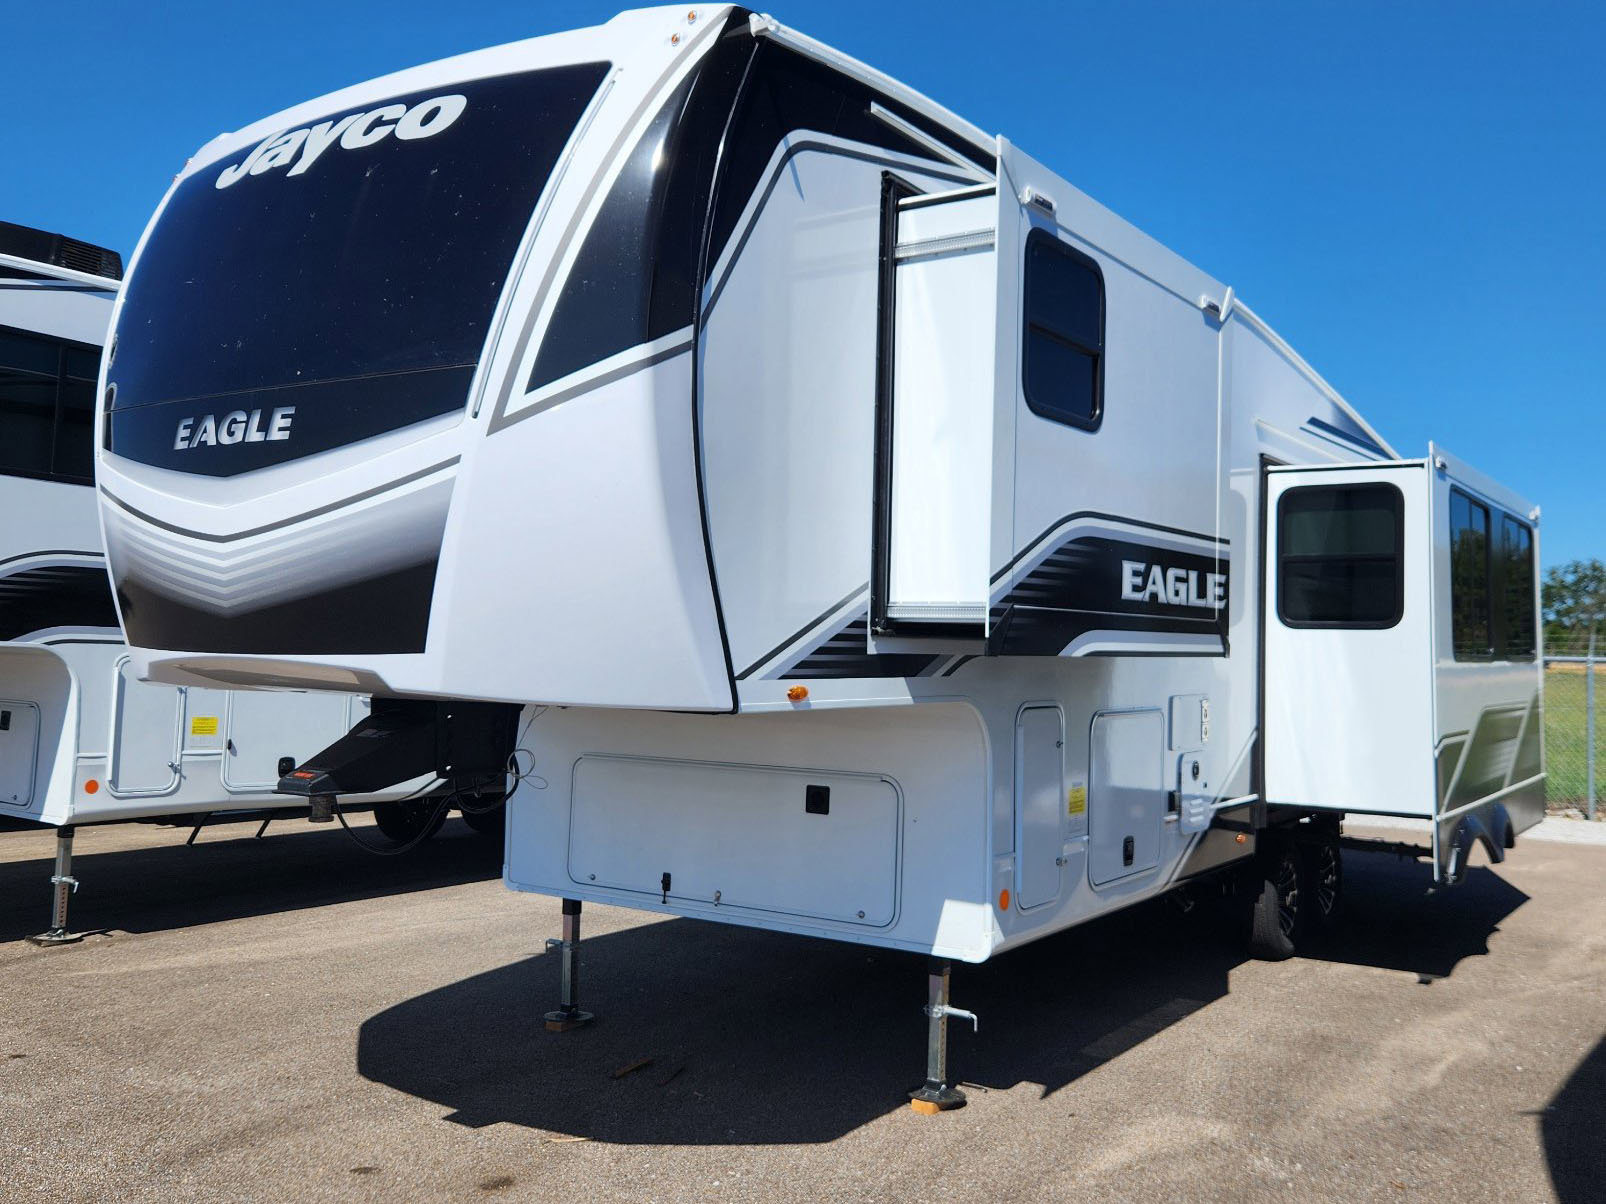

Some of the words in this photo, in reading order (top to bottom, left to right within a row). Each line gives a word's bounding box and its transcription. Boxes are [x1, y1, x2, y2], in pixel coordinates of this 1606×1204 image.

[215, 94, 467, 189] Jayco
[173, 406, 296, 450] EAGLE
[1121, 560, 1227, 609] EAGLE
